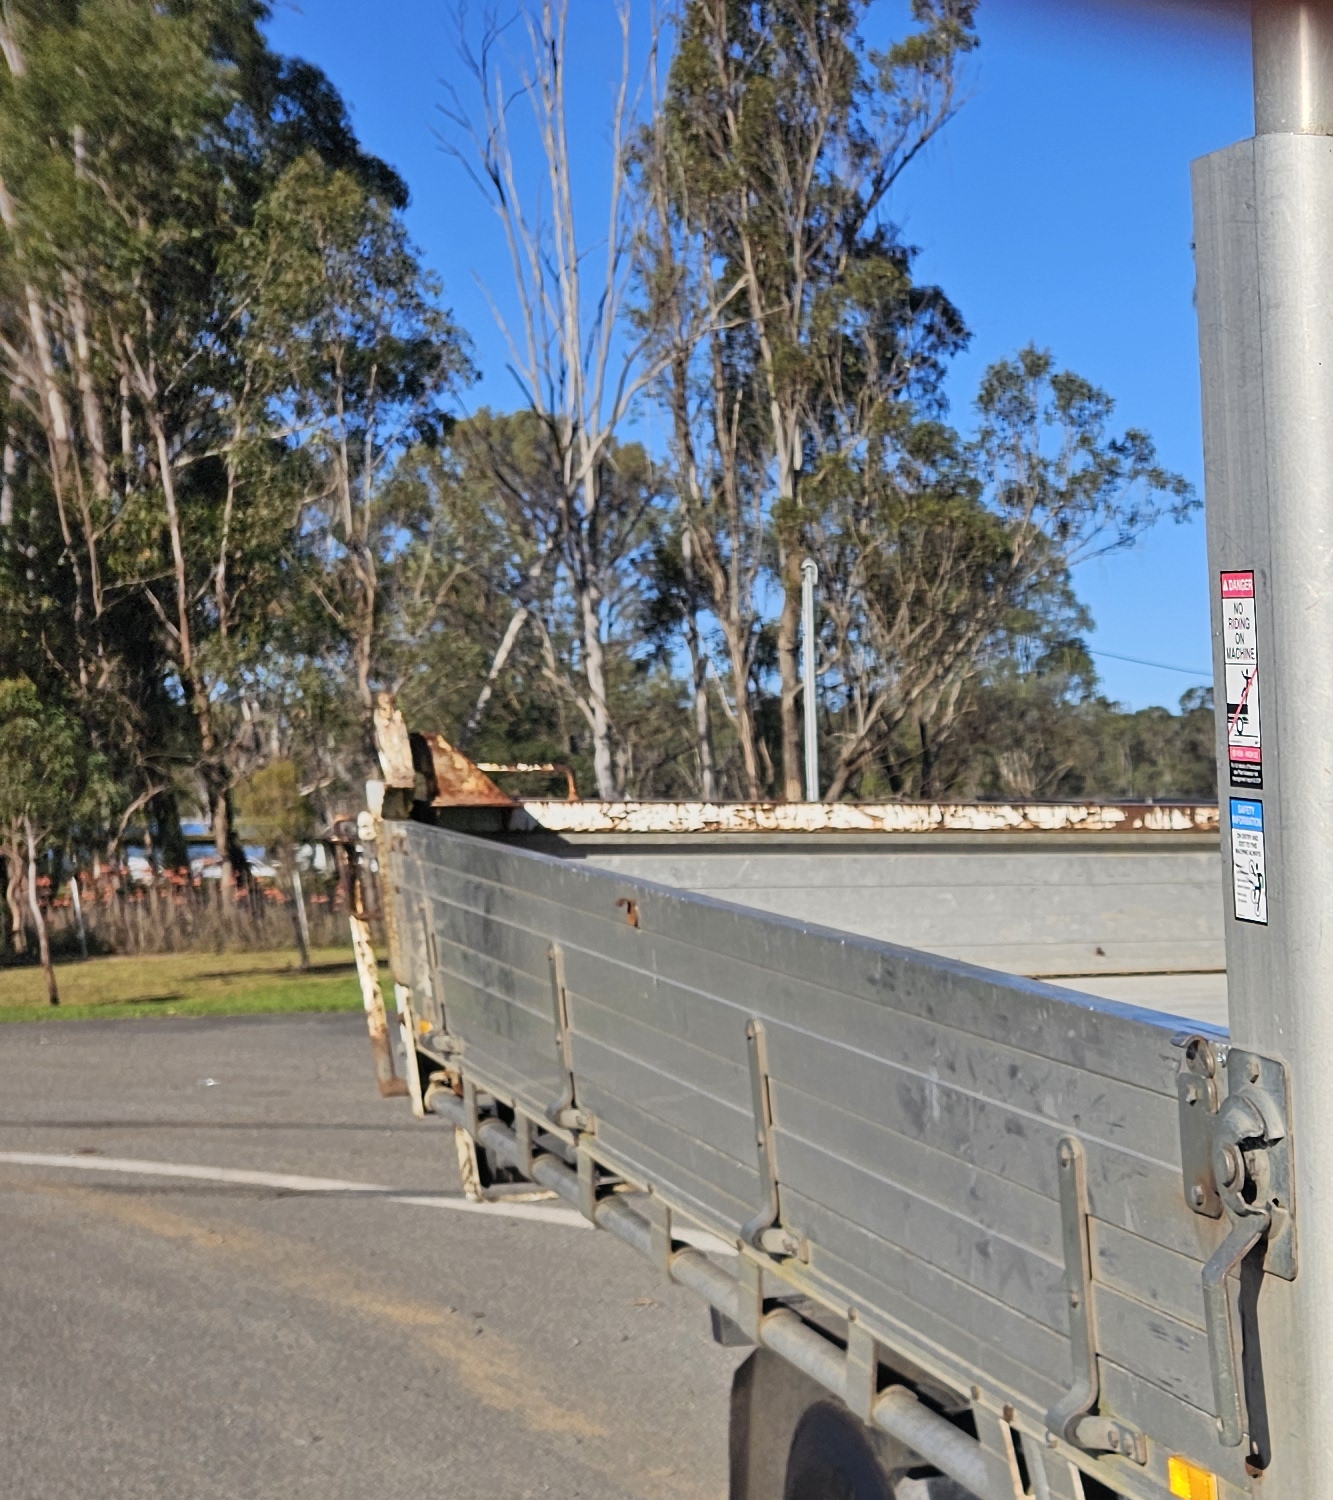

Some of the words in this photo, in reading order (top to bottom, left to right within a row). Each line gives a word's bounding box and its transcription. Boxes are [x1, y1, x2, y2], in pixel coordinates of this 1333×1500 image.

[1228, 579, 1253, 591] DANGER
[1233, 602, 1244, 615] NO
[1228, 617, 1250, 630] RIDING
[1235, 632, 1245, 645] ON
[1226, 647, 1255, 660] MACHINE
